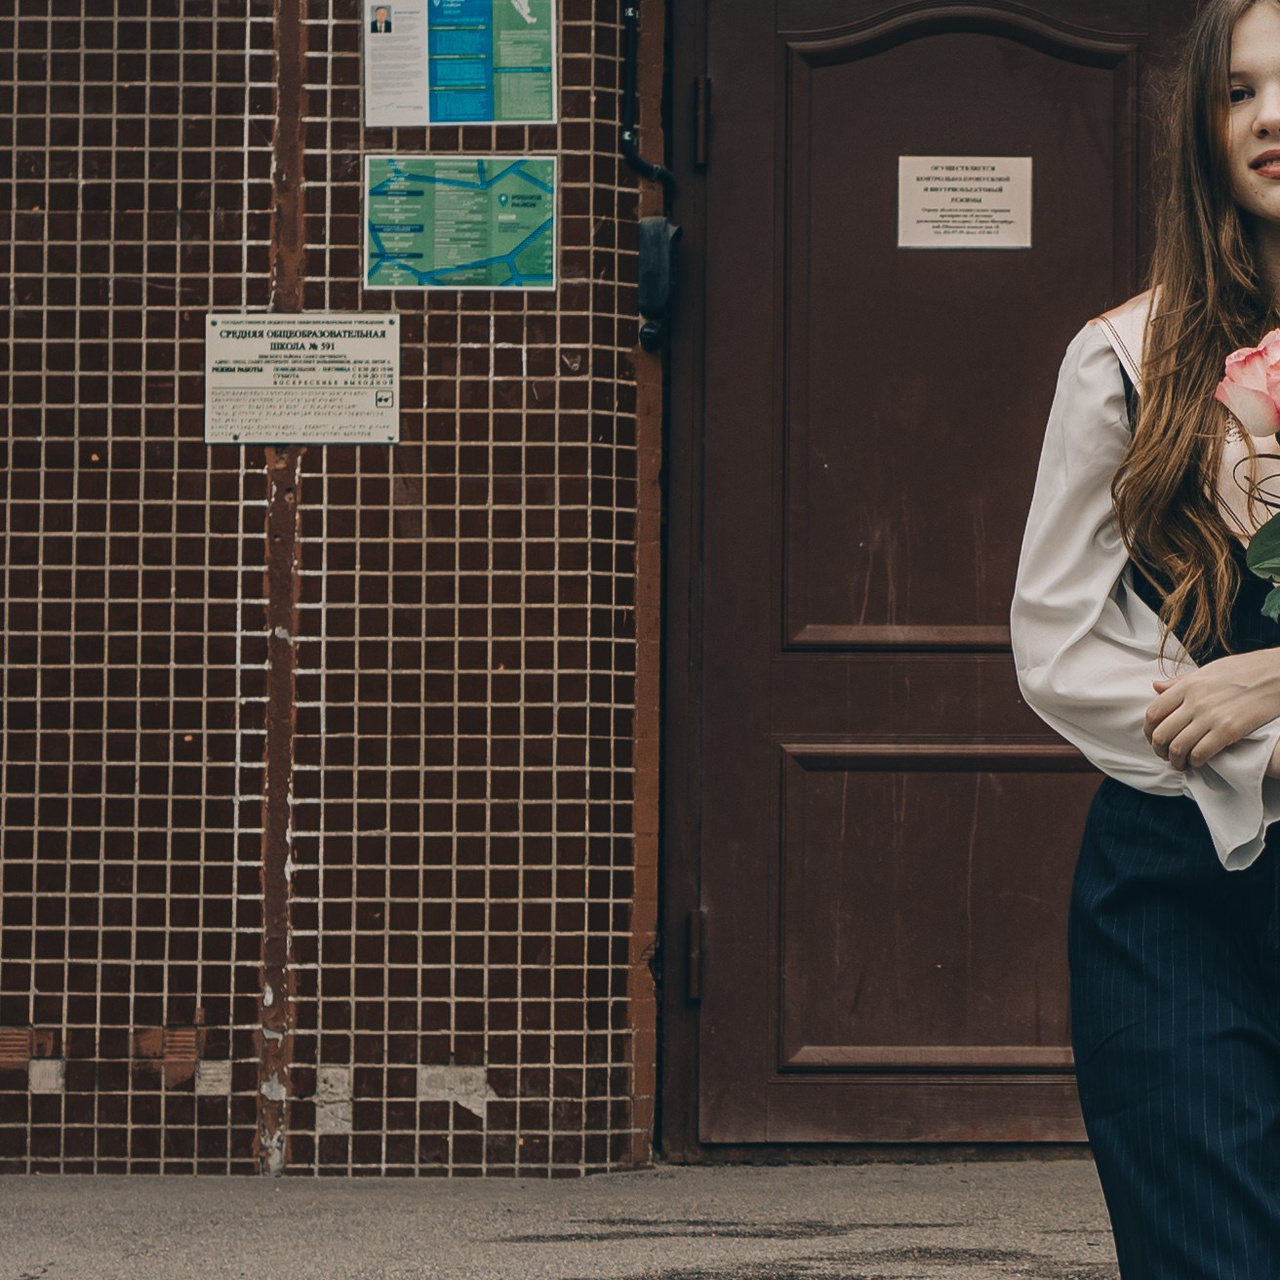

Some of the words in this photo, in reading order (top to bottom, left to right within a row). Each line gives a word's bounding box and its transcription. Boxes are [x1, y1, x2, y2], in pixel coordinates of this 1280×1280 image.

[219, 330, 264, 339] СРЕДНЯЯ
[266, 330, 386, 339] ОБЩЕОБРАЗОВАТЕЛЬНАЯ
[270, 342, 305, 351] ШКОЛА
[308, 342, 318, 351] №
[321, 342, 335, 351] 591
